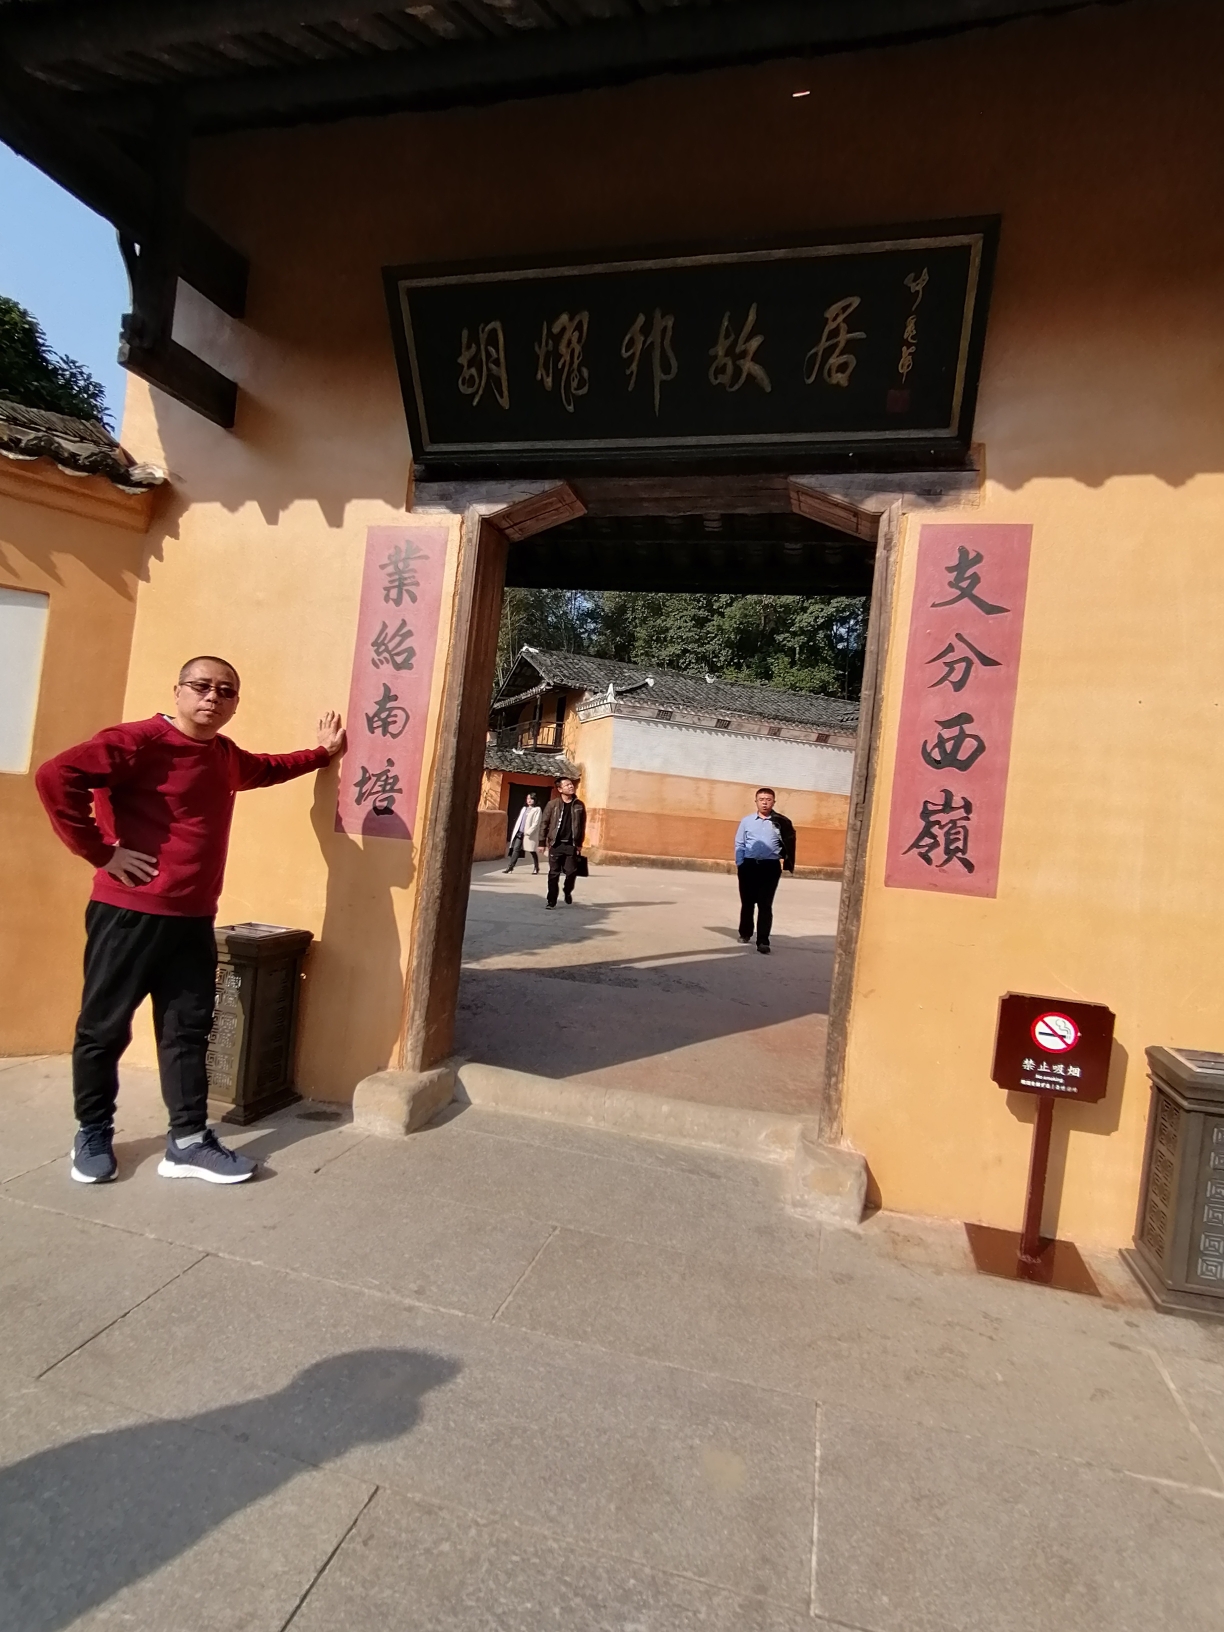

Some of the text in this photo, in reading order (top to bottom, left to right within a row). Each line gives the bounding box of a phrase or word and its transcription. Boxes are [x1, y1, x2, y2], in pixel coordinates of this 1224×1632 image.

[902, 545, 1011, 874] 支分西嶺
[1022, 1058, 1081, 1077] 禁止吸烟
